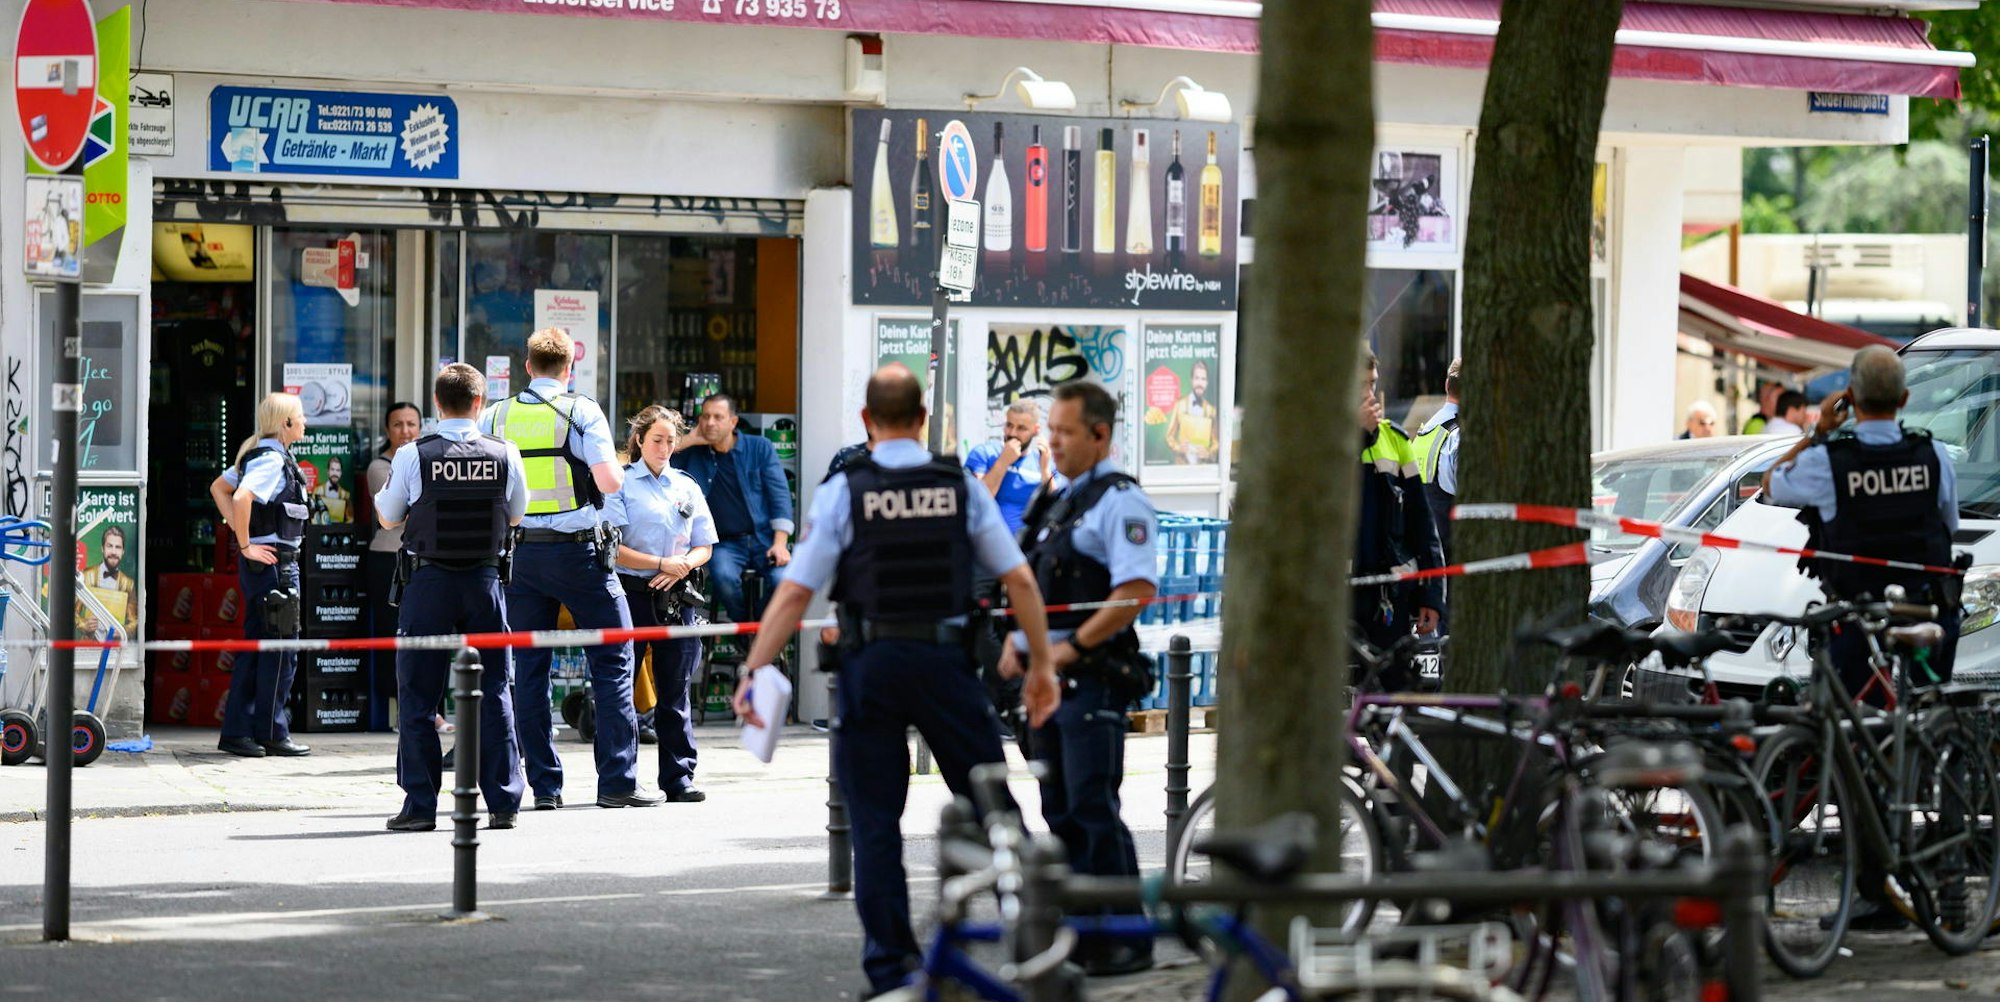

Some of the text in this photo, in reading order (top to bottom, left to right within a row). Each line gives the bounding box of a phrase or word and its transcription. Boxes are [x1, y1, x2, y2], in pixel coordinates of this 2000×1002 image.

[735, 0, 760, 16] 73
[765, 0, 807, 18] 935
[814, 0, 841, 20] 73
[228, 95, 311, 131] UCAR
[365, 106, 376, 119] 90
[140, 123, 166, 133] Fahrzeuge
[409, 115, 437, 134] Exklusive
[281, 138, 337, 160] Getränke
[349, 141, 388, 161] Markt
[950, 217, 974, 234] ezone
[879, 325, 909, 339] Deine
[910, 325, 933, 339] Kart
[1146, 330, 1217, 344] Deine Karte ist
[879, 340, 928, 358] jetzt Gold
[1146, 345, 1218, 363] jetzt Gold wert.
[328, 367, 349, 375] STYLE
[509, 421, 551, 437] POLIZEI
[316, 432, 337, 443] Karte
[338, 432, 349, 443] ist
[311, 444, 330, 455] Gold
[330, 445, 351, 455] wert.
[431, 461, 498, 481] POLIZEI
[1847, 464, 1930, 497] POLIZEI
[82, 490, 116, 506] Karte
[118, 491, 135, 506] ist
[863, 487, 958, 521] POLIZEI
[316, 553, 360, 563] Franziskaner
[316, 605, 360, 615] Franziskaner
[316, 657, 360, 667] Franziskaner
[316, 709, 360, 719] Franziskaner
